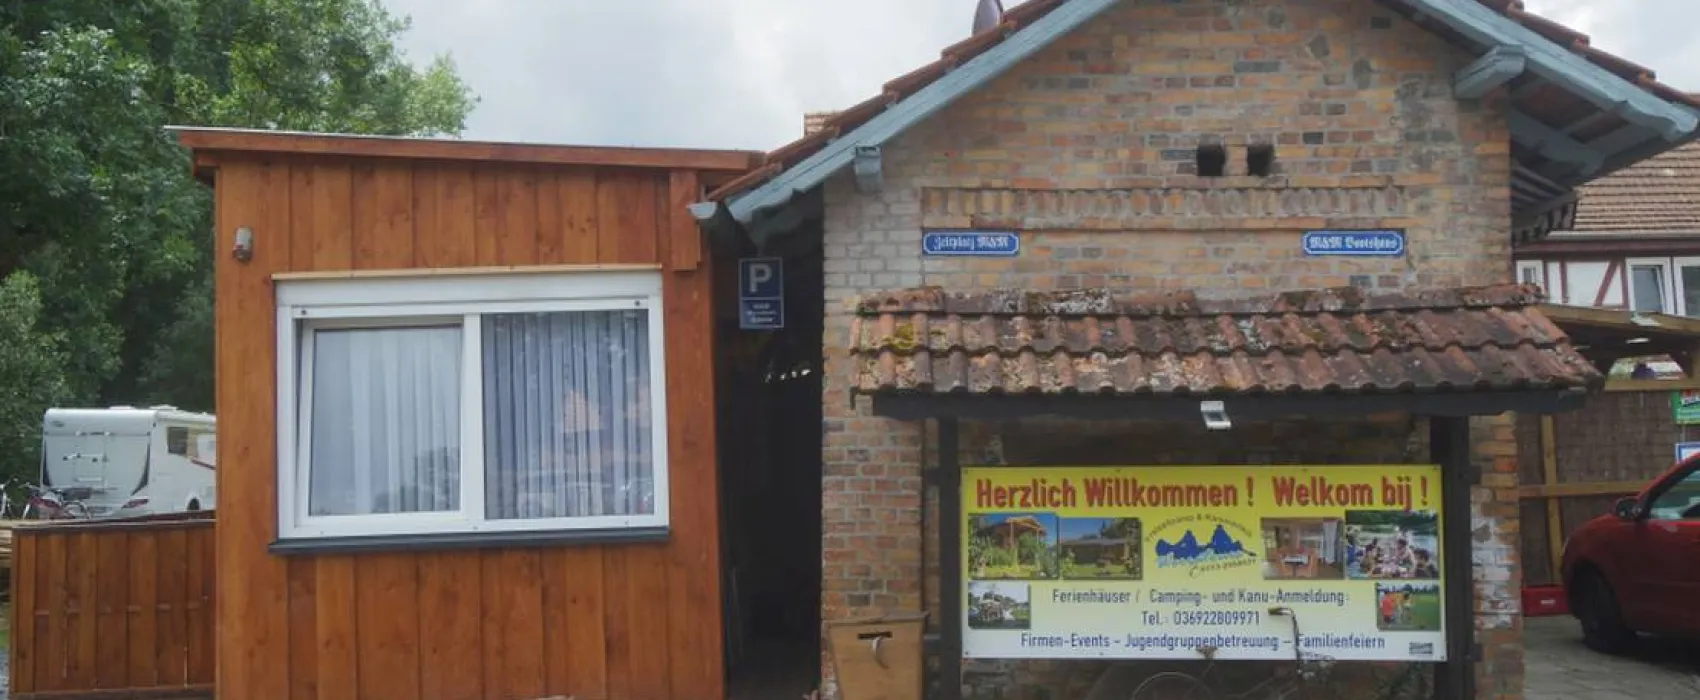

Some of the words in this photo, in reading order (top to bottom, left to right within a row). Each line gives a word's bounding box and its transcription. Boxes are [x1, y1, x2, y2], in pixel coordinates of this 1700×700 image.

[749, 264, 772, 292] P
[976, 478, 1077, 508] Herzlich
[1083, 477, 1238, 507] Willkommen
[1272, 476, 1373, 507] Welkom
[1381, 475, 1413, 511] bij
[1052, 588, 1132, 604] Ferienhäuser
[1212, 588, 1235, 603] und
[1173, 610, 1260, 625] 036922809971
[1021, 632, 1110, 648] Firmen-Events
[1125, 633, 1279, 651] Jugendgruppenbetreuung
